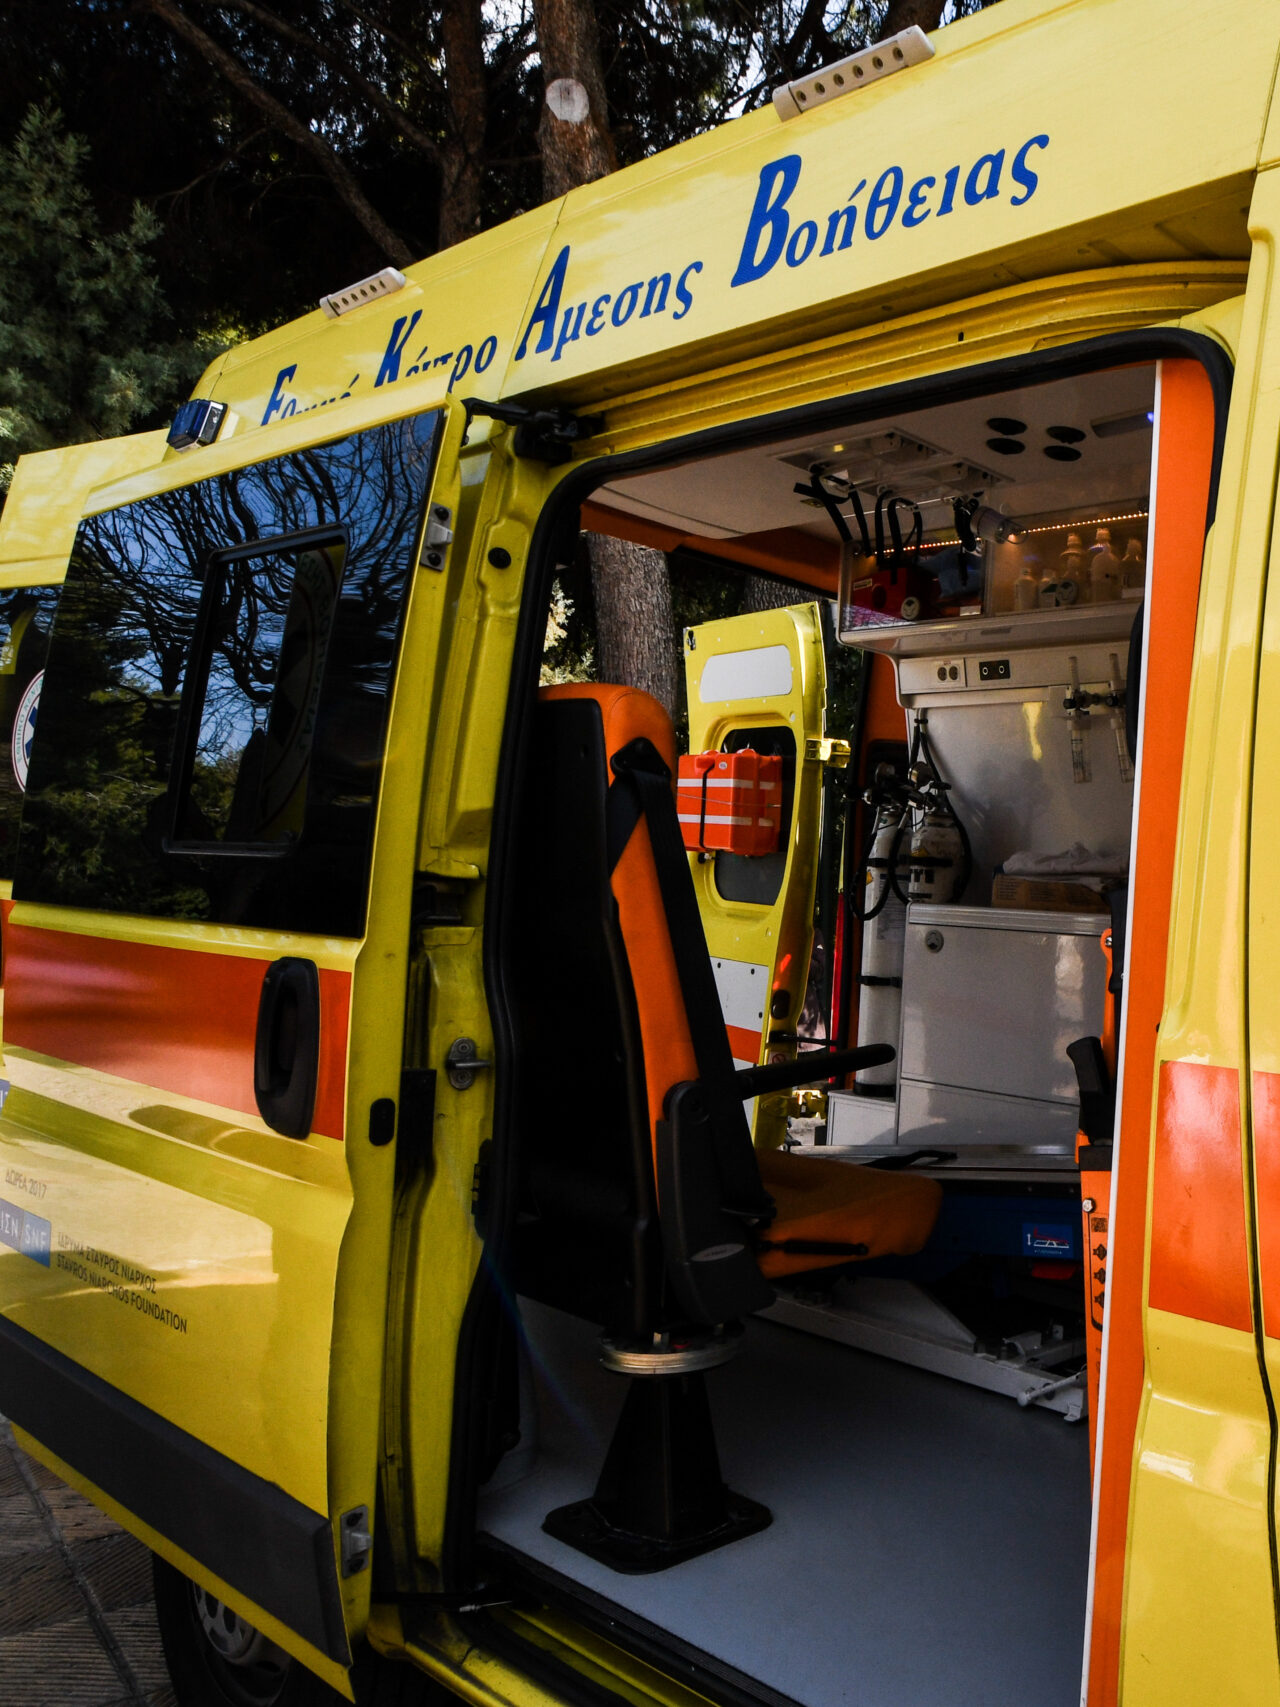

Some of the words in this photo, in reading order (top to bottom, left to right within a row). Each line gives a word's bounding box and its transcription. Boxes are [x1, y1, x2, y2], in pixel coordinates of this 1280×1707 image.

[514, 244, 704, 362] Αμεσης
[730, 133, 1050, 288] Βοήθειας
[29, 1178, 47, 1199] 2017
[25, 1223, 48, 1252] SNF
[57, 1253, 88, 1282] STAVROS
[89, 1271, 129, 1304] NIARCHOS
[130, 1291, 188, 1333] FOUNDATION
[86, 1245, 120, 1276] ΣΤΑΥΡΟΣ
[121, 1264, 157, 1294] ΝΙΑΡΧΟΣ
